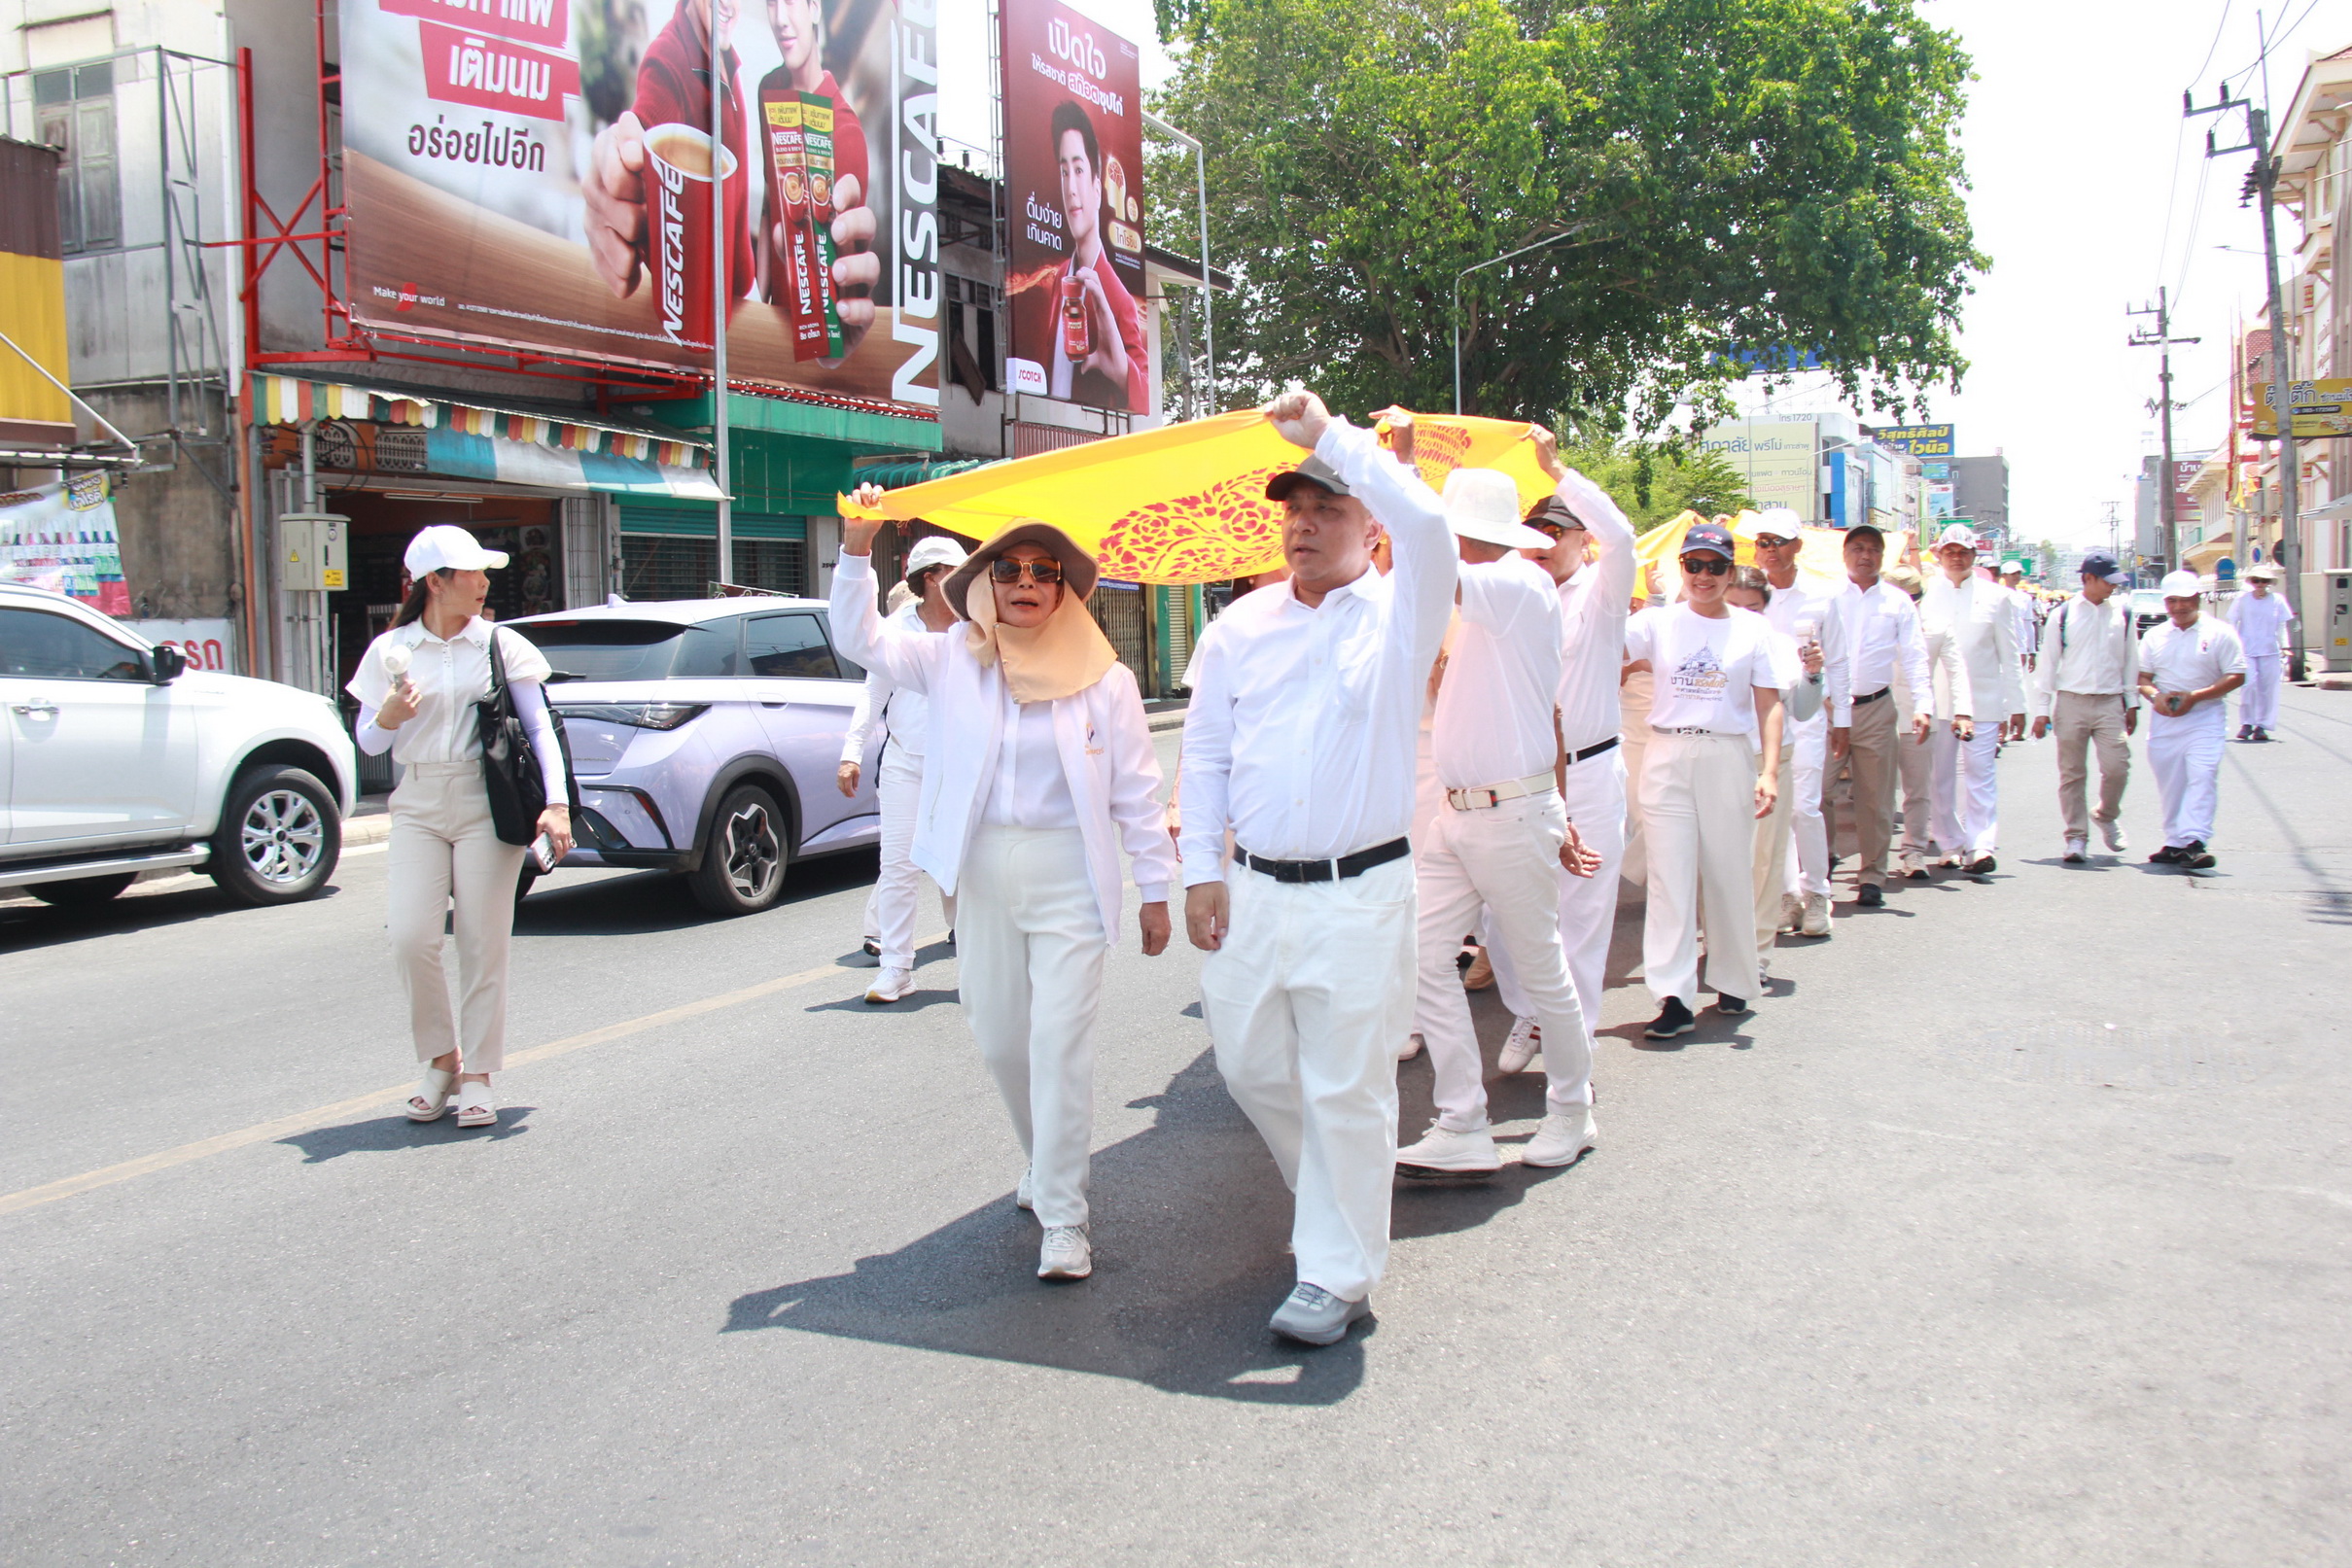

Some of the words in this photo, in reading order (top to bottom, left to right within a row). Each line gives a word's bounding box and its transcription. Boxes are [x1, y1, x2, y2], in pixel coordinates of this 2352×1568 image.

[1048, 17, 1106, 80] เปิดใจ
[448, 37, 550, 101] เติมนม
[408, 114, 545, 173] อร่อยไปอีก
[1027, 192, 1063, 229] ดื่มง่าย
[1027, 223, 1063, 251] เกินคาด
[373, 286, 398, 299] Make
[399, 292, 418, 302] your
[420, 296, 445, 307] world
[1792, 413, 1812, 422] 1720
